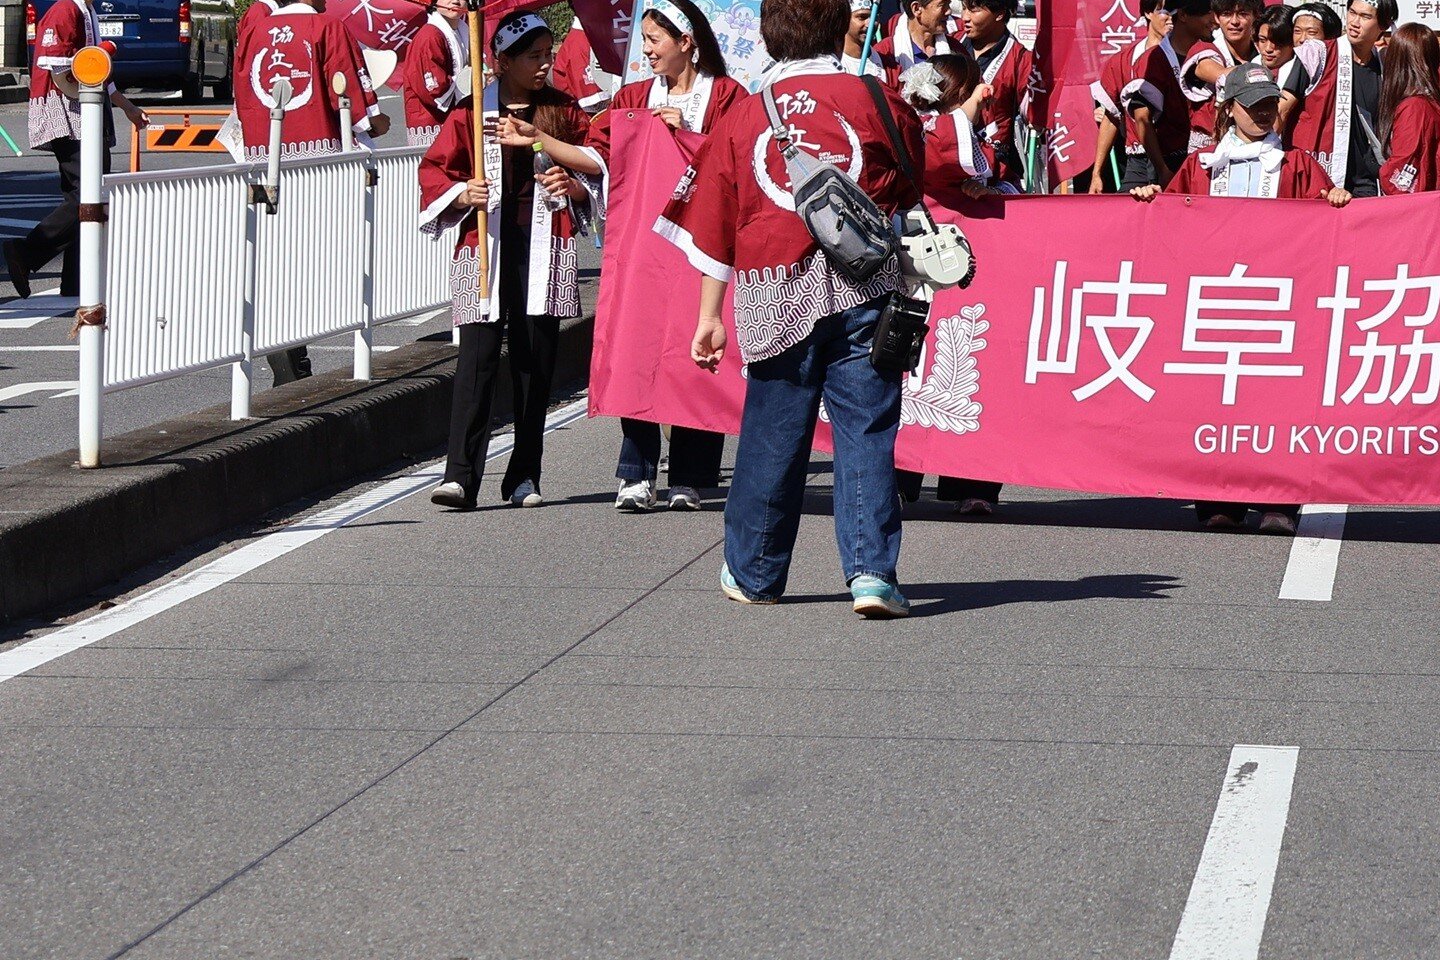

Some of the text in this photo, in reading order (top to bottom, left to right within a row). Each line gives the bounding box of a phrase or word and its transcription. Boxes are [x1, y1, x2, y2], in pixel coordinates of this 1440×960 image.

[1336, 54, 1351, 131] 岐阜協立大学
[1194, 424, 1275, 454] GIFU
